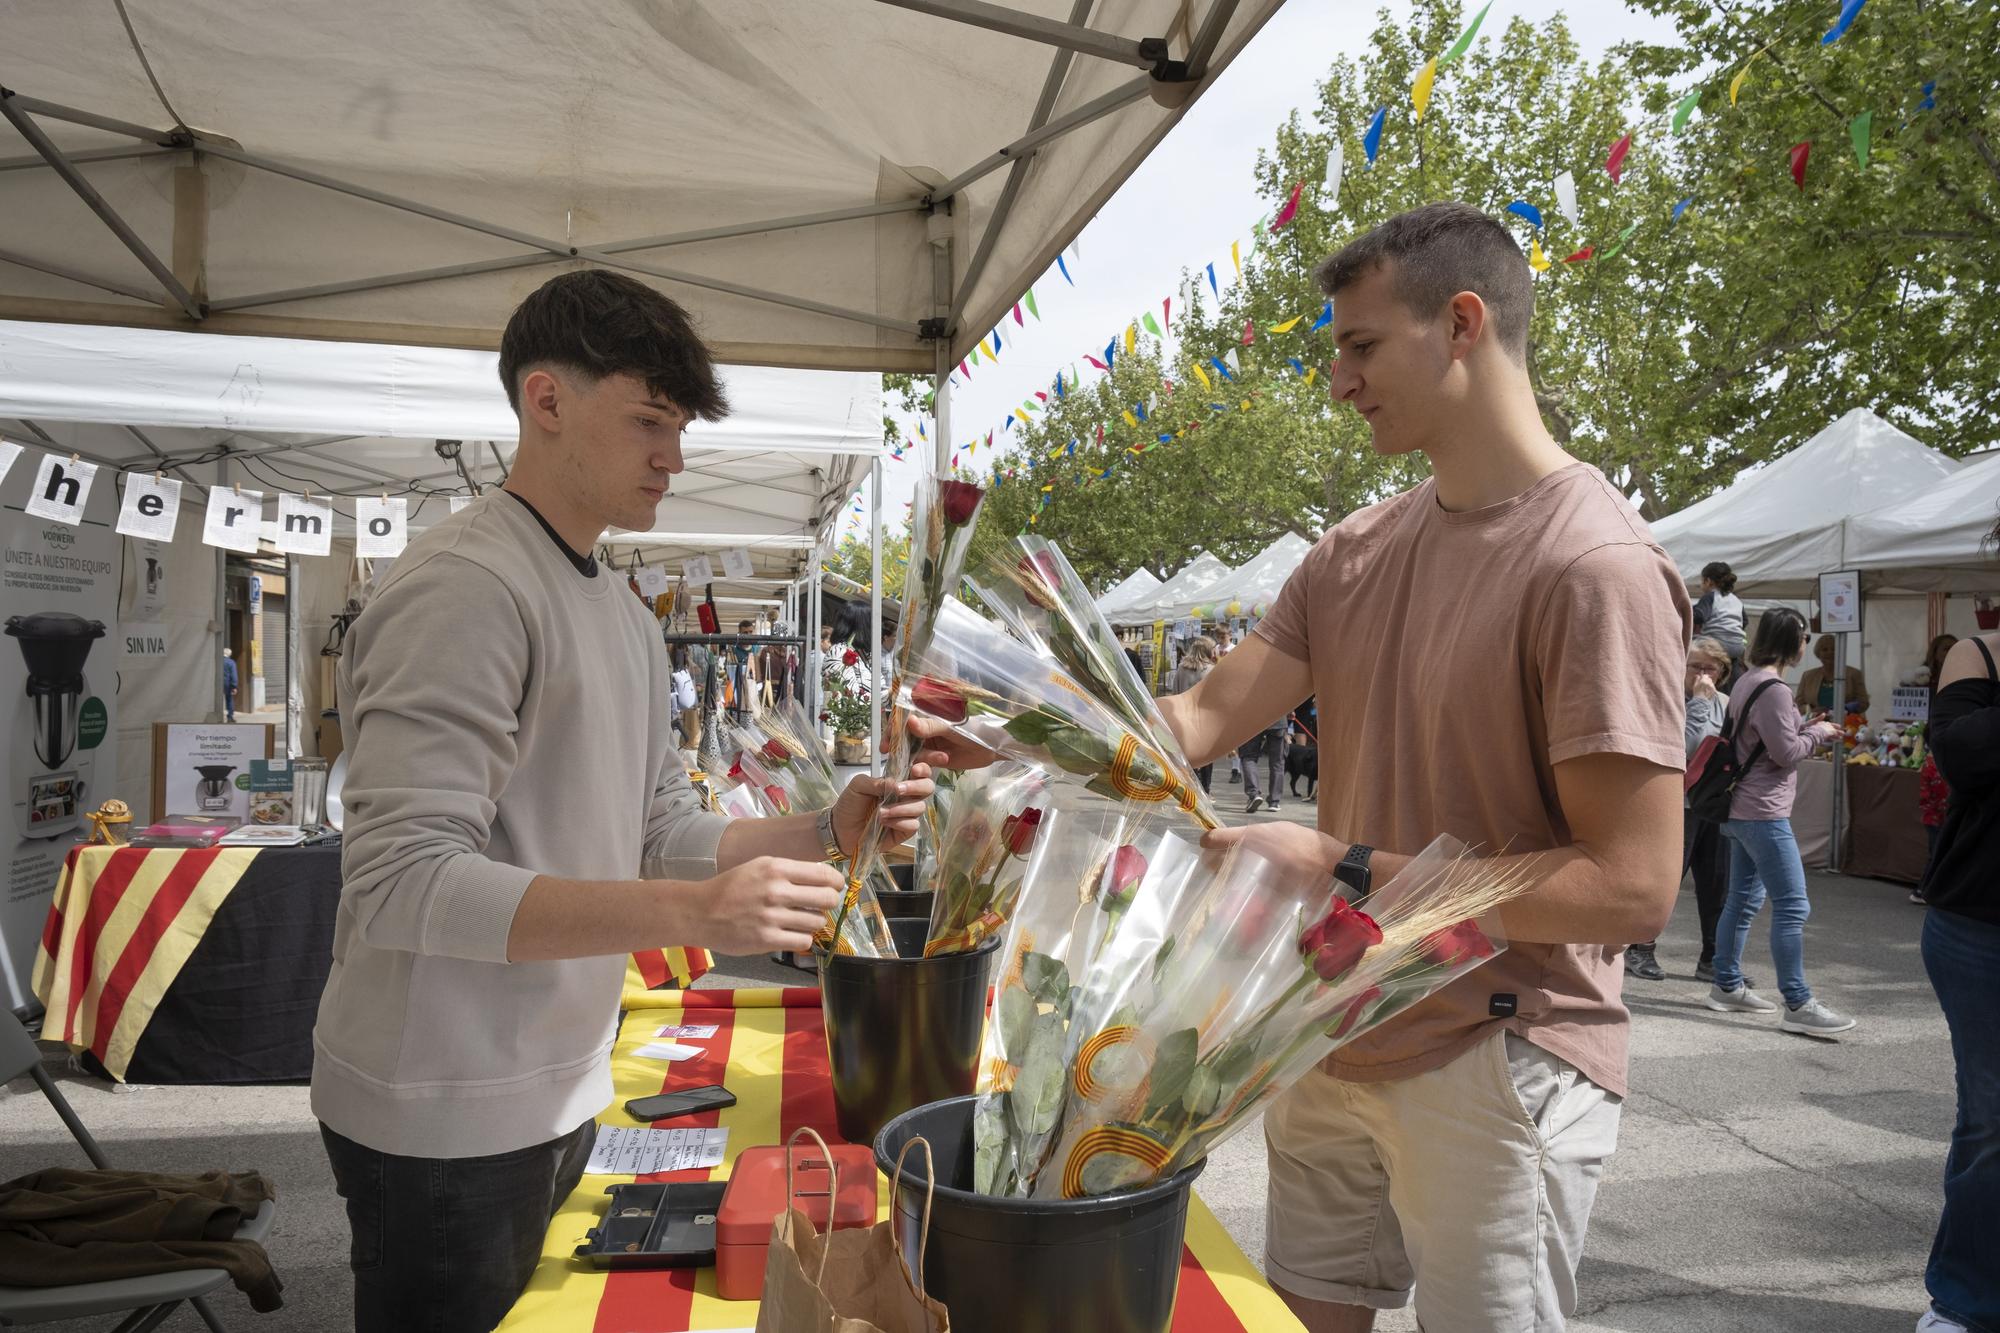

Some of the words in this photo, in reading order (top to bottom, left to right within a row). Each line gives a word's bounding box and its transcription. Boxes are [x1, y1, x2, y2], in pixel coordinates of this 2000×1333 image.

[42, 530, 75, 545] VORWERK
[5, 546, 33, 566] ÚNETE
[35, 553, 42, 567] A
[43, 555, 81, 572] NUESTRO
[82, 560, 112, 576] EQUIPO
[126, 637, 144, 653] SIN
[147, 638, 165, 653] IVA
[209, 734, 237, 742] tiempo
